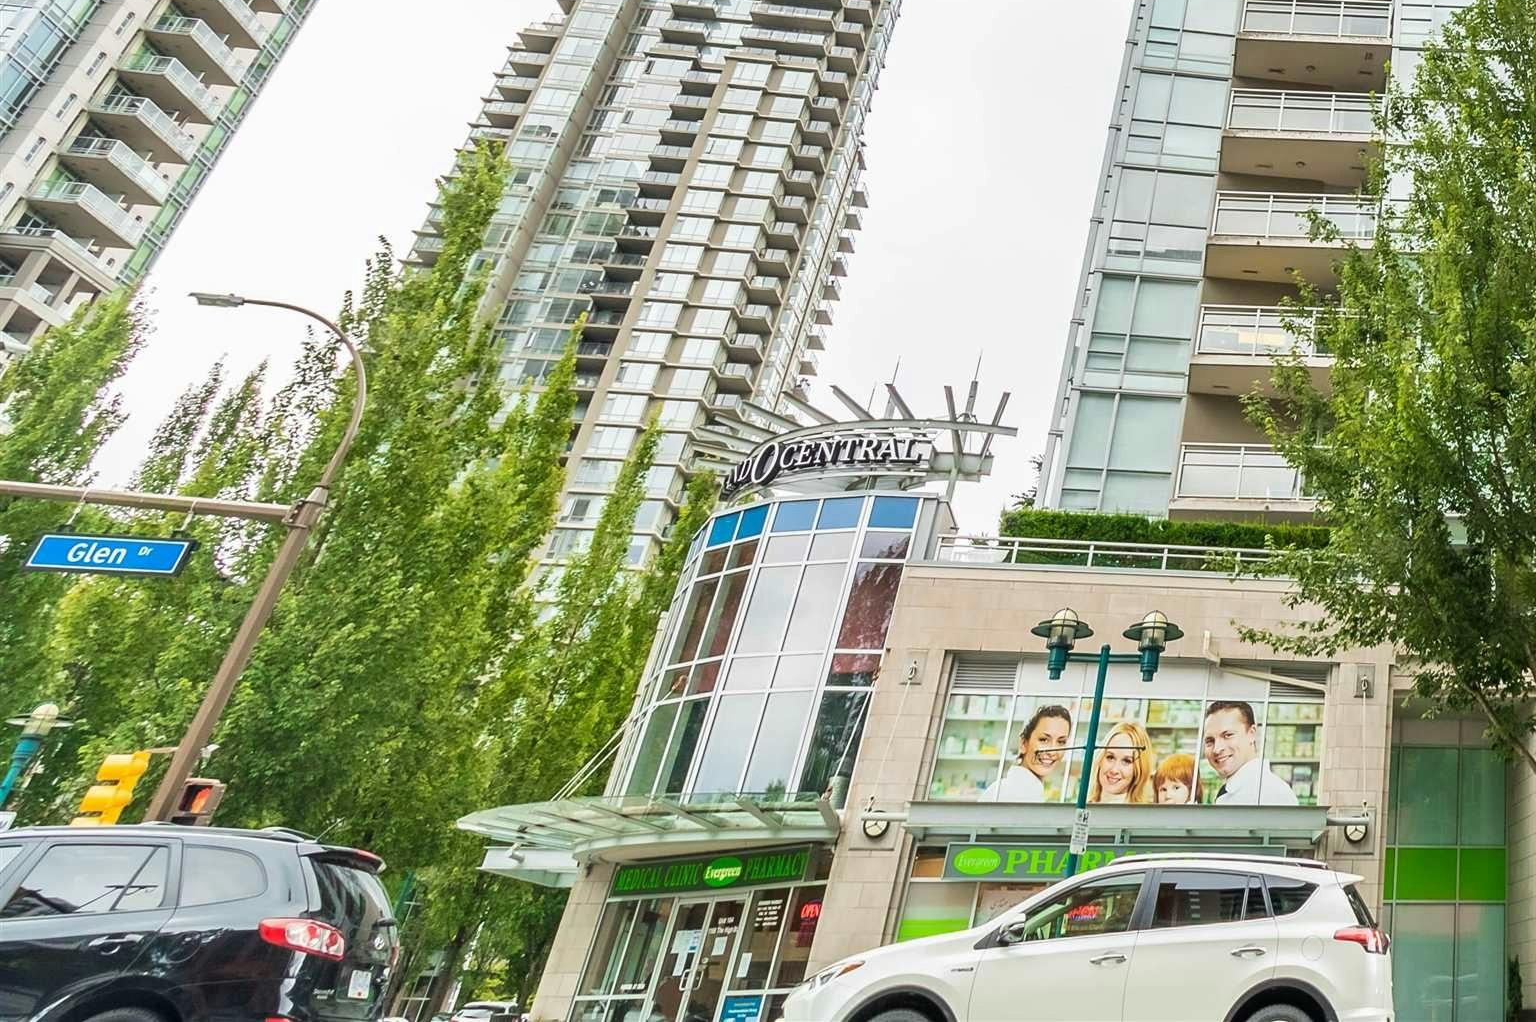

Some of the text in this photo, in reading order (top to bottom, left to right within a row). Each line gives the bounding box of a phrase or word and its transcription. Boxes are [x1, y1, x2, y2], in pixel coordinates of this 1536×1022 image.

[780, 437, 923, 469] CENTRAL
[66, 542, 153, 564] Glen Dr
[744, 852, 809, 881] PHARMACY
[958, 853, 999, 869] Evergreen
[616, 862, 703, 891] MEDICAL CLINIC
[703, 864, 742, 882] Evergreen
[801, 904, 821, 918] OPEN
